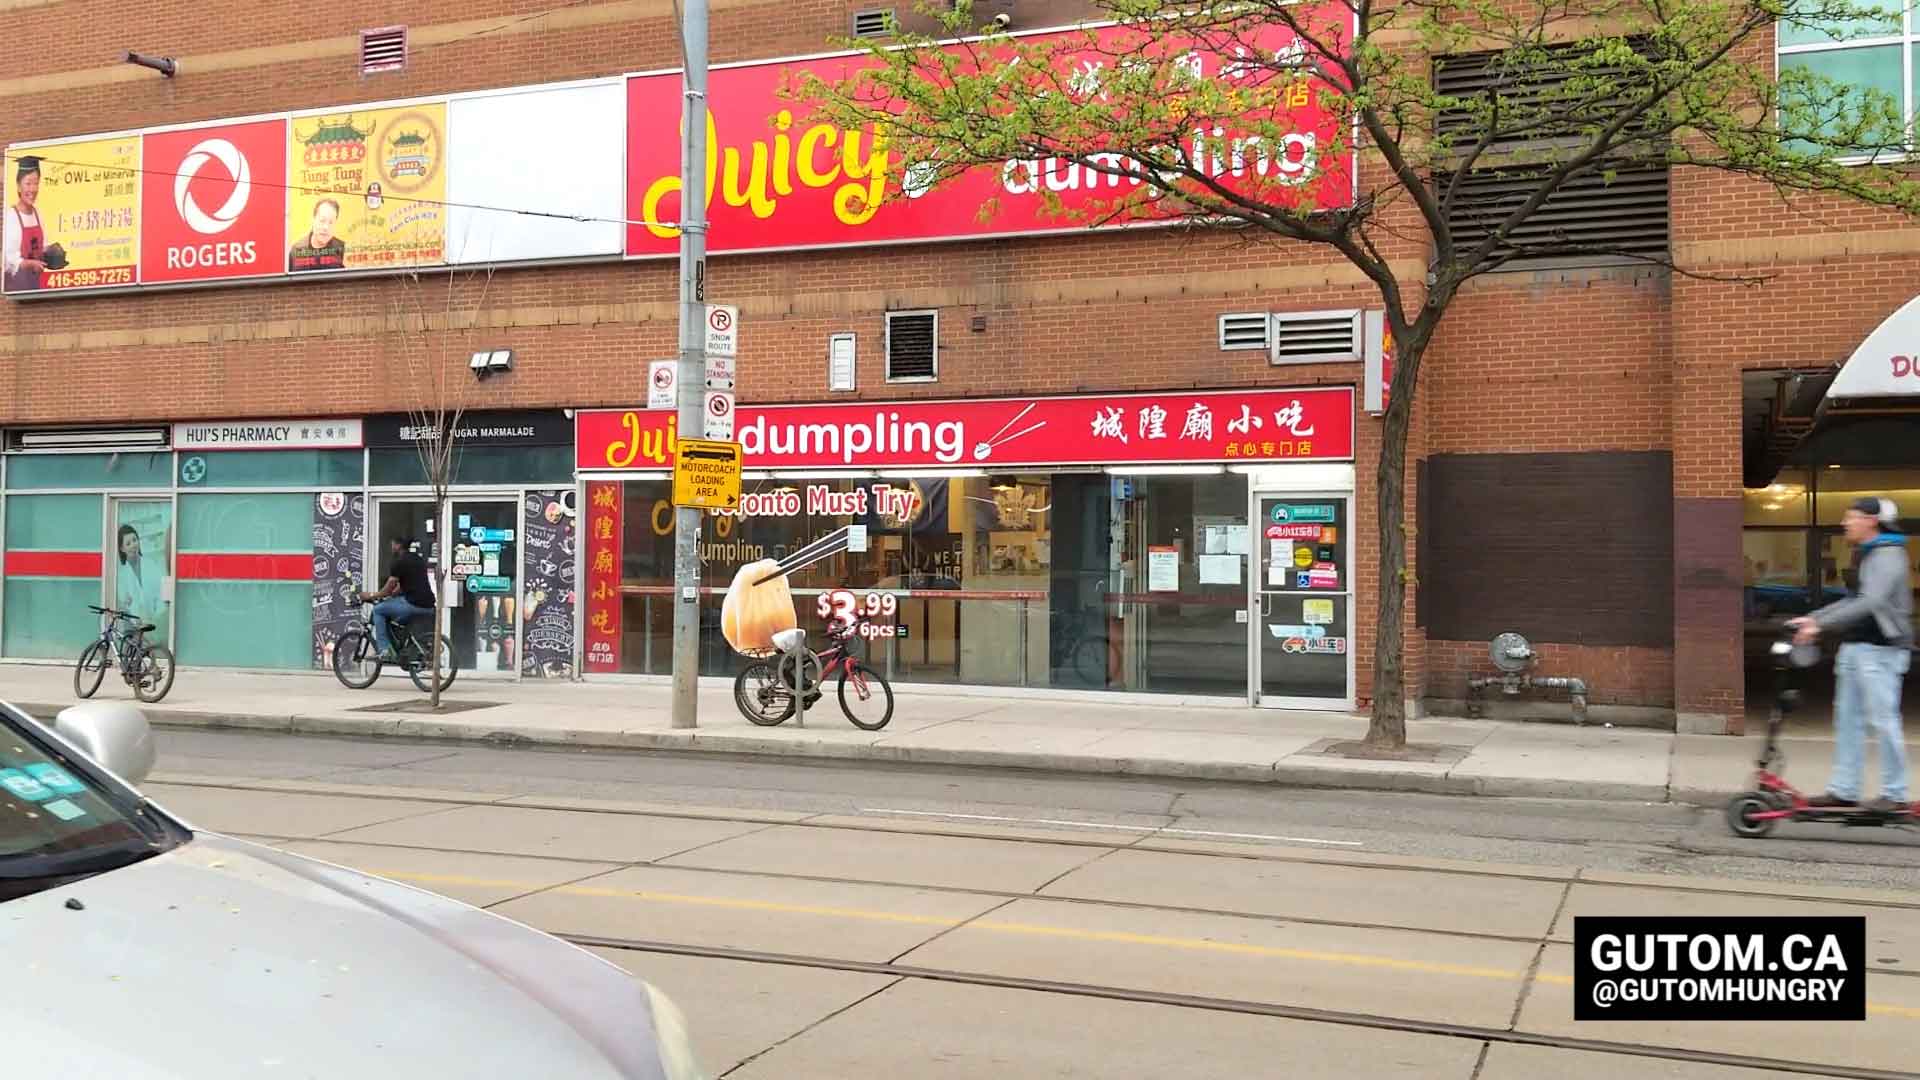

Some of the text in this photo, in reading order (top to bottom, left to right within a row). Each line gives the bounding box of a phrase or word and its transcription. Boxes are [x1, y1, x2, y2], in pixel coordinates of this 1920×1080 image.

[64, 170, 91, 184] OWL
[642, 109, 890, 239] Juicy
[167, 241, 257, 269] ROGERS
[47, 268, 131, 288] 416-599-7275
[711, 333, 731, 342] SNOW
[708, 342, 731, 351] ROUTE
[715, 360, 726, 370] NO
[186, 426, 290, 442] HUI'S PHARMACY
[480, 427, 536, 438] MARMALADE
[738, 412, 964, 462] dumpling
[1224, 441, 1313, 456] 点心专门店
[681, 462, 736, 474] MOTORCOACH
[690, 474, 725, 486] LOADING
[696, 487, 718, 497] AREA
[806, 484, 868, 516] Must
[871, 483, 915, 522] Try
[860, 621, 895, 641] 6pcs
